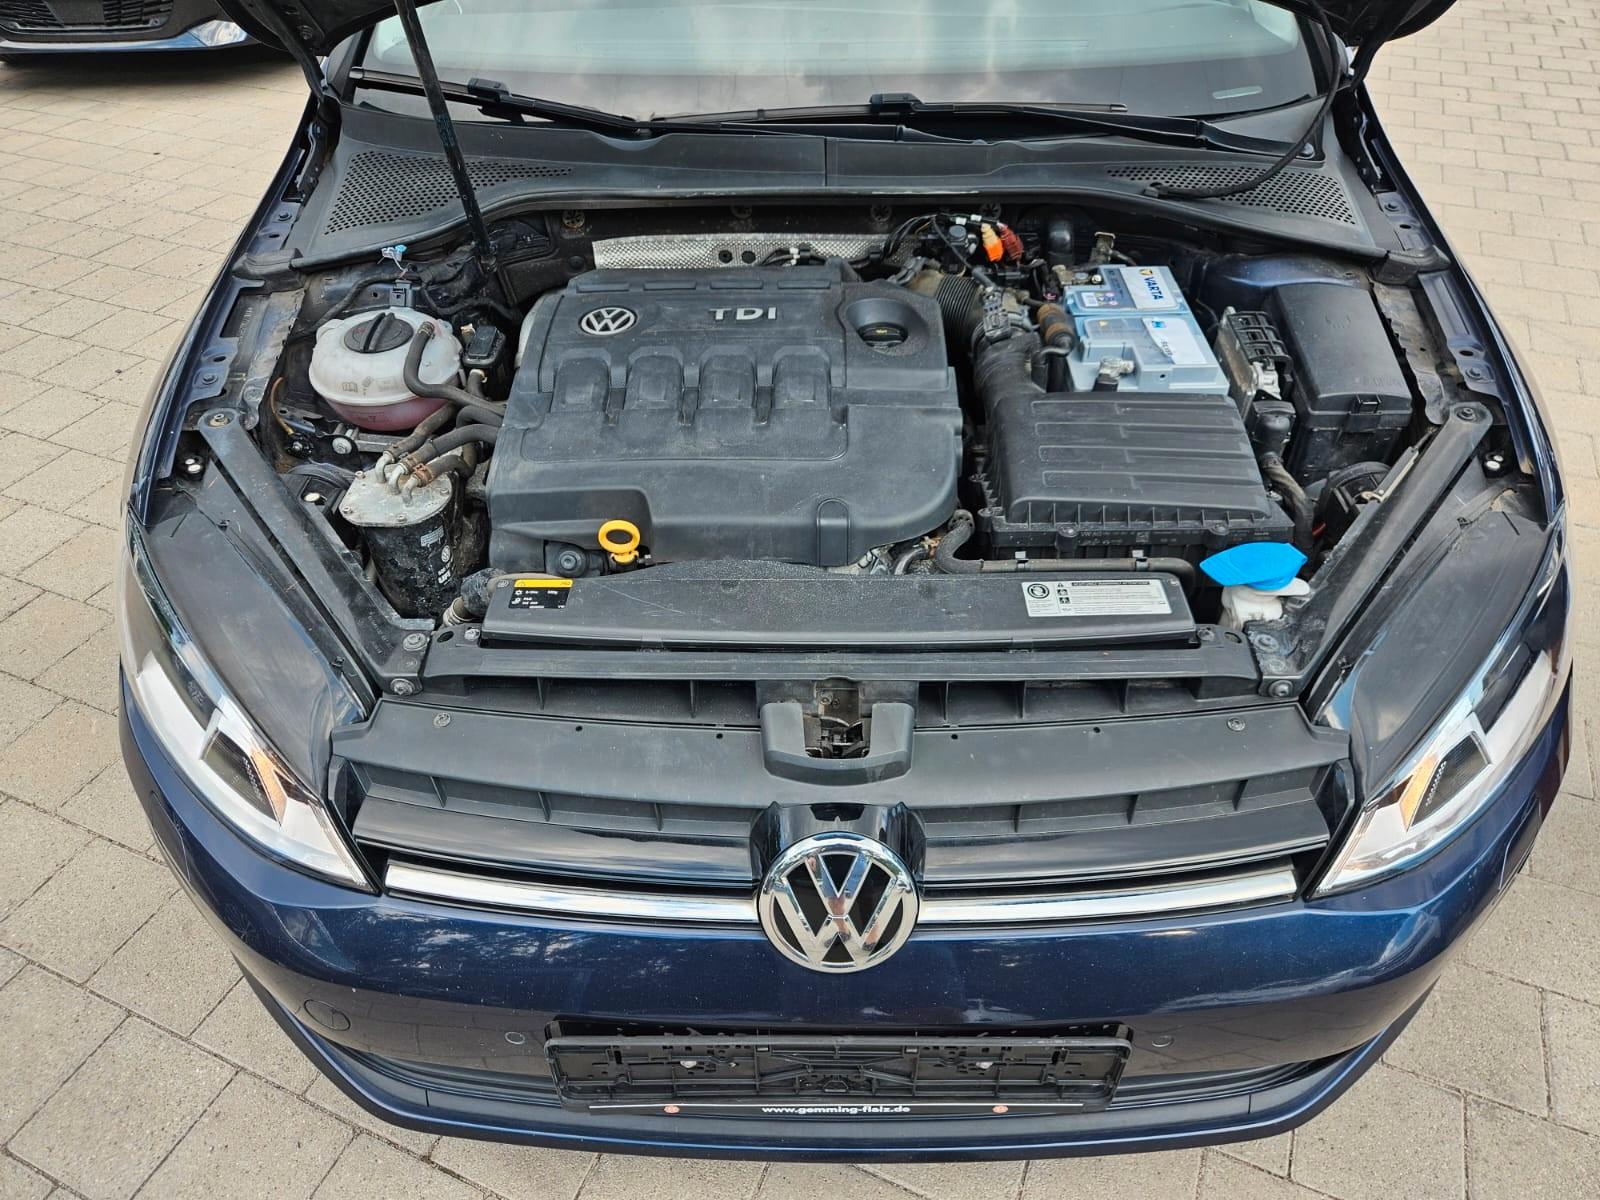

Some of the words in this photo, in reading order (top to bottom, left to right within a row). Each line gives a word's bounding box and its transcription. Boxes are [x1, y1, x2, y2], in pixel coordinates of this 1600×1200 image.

[1144, 276, 1164, 300] VARTA
[709, 307, 777, 320] TDI
[768, 848, 909, 966] VW
